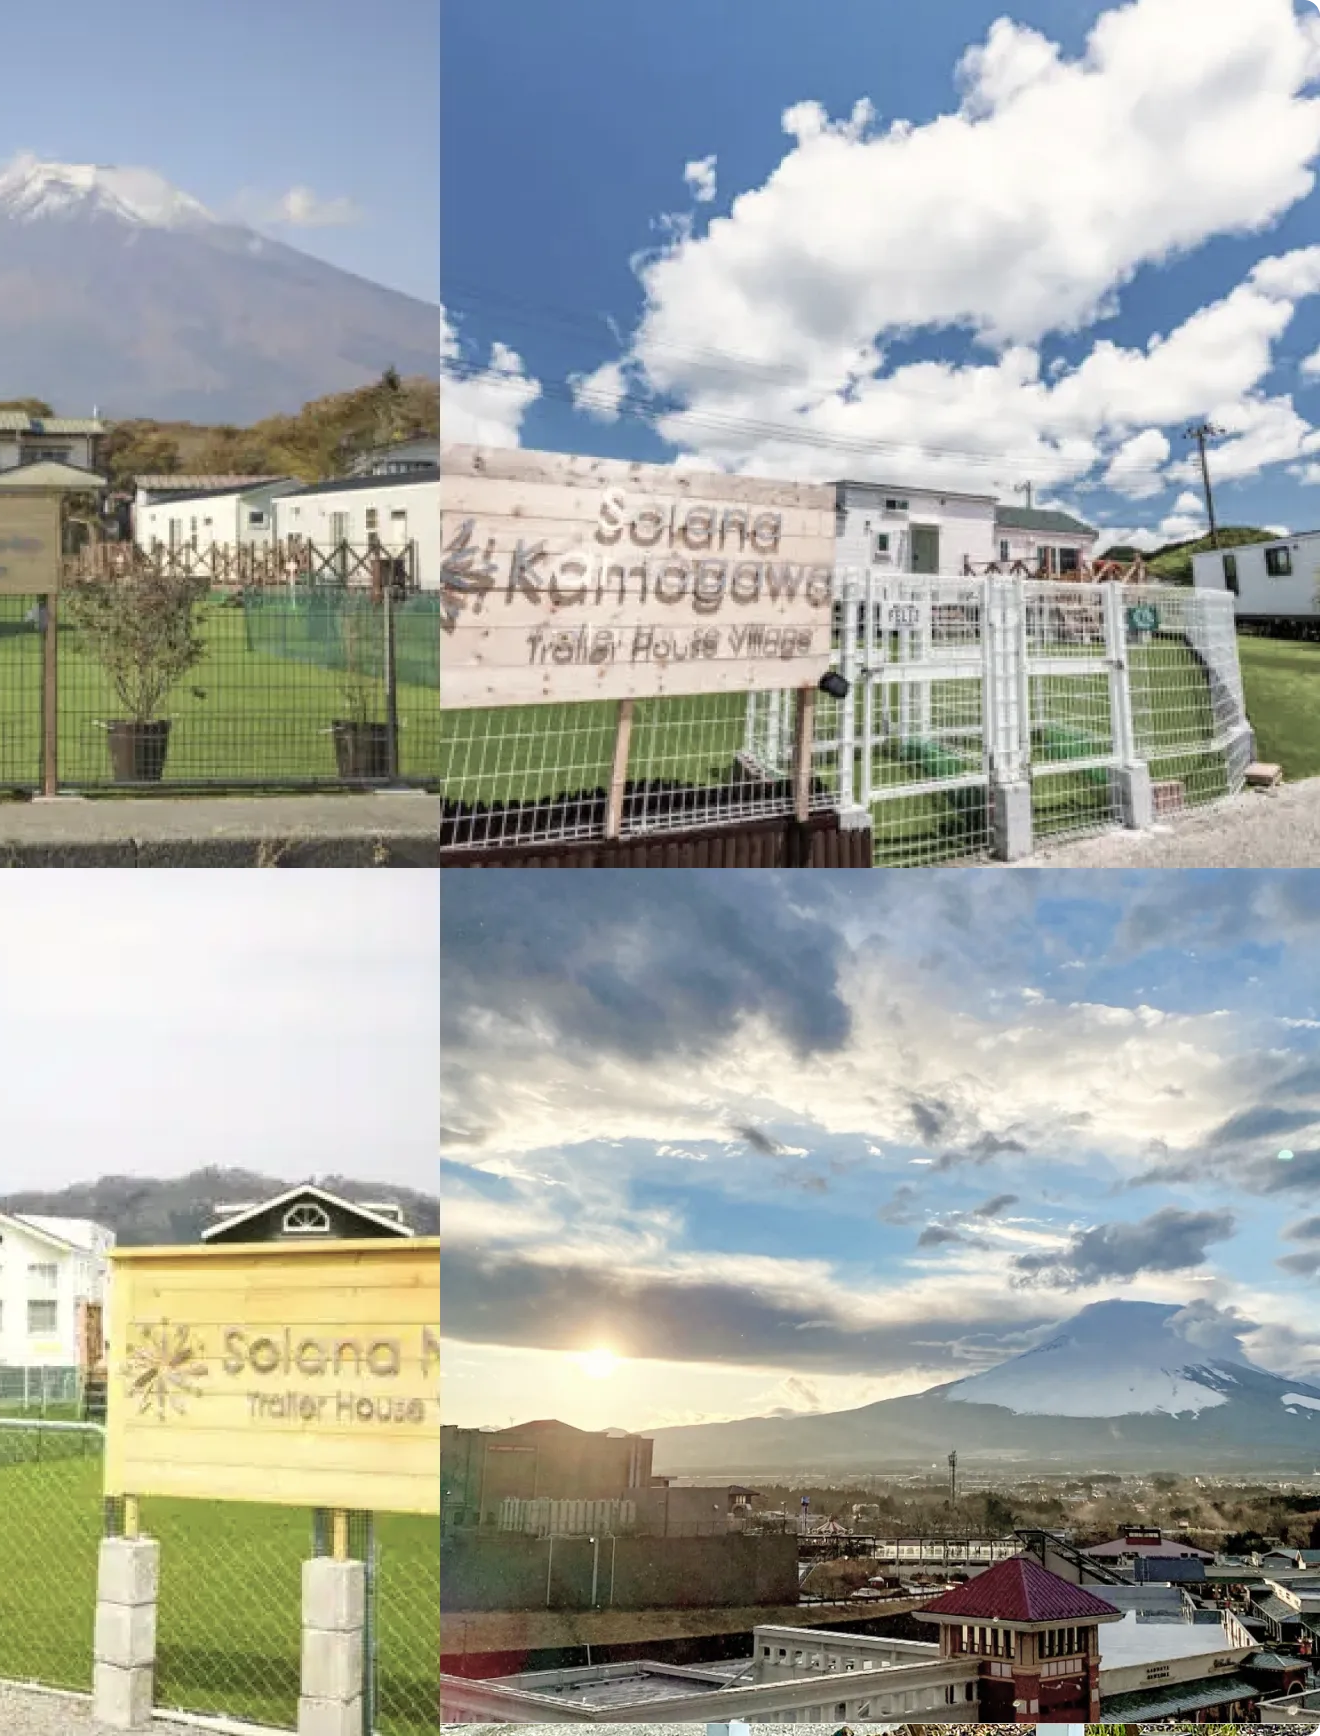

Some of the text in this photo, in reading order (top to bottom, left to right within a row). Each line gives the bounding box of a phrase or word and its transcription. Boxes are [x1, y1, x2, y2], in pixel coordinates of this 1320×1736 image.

[594, 487, 782, 554] Solana
[223, 1327, 401, 1377] Solana
[336, 1390, 425, 1424] House
